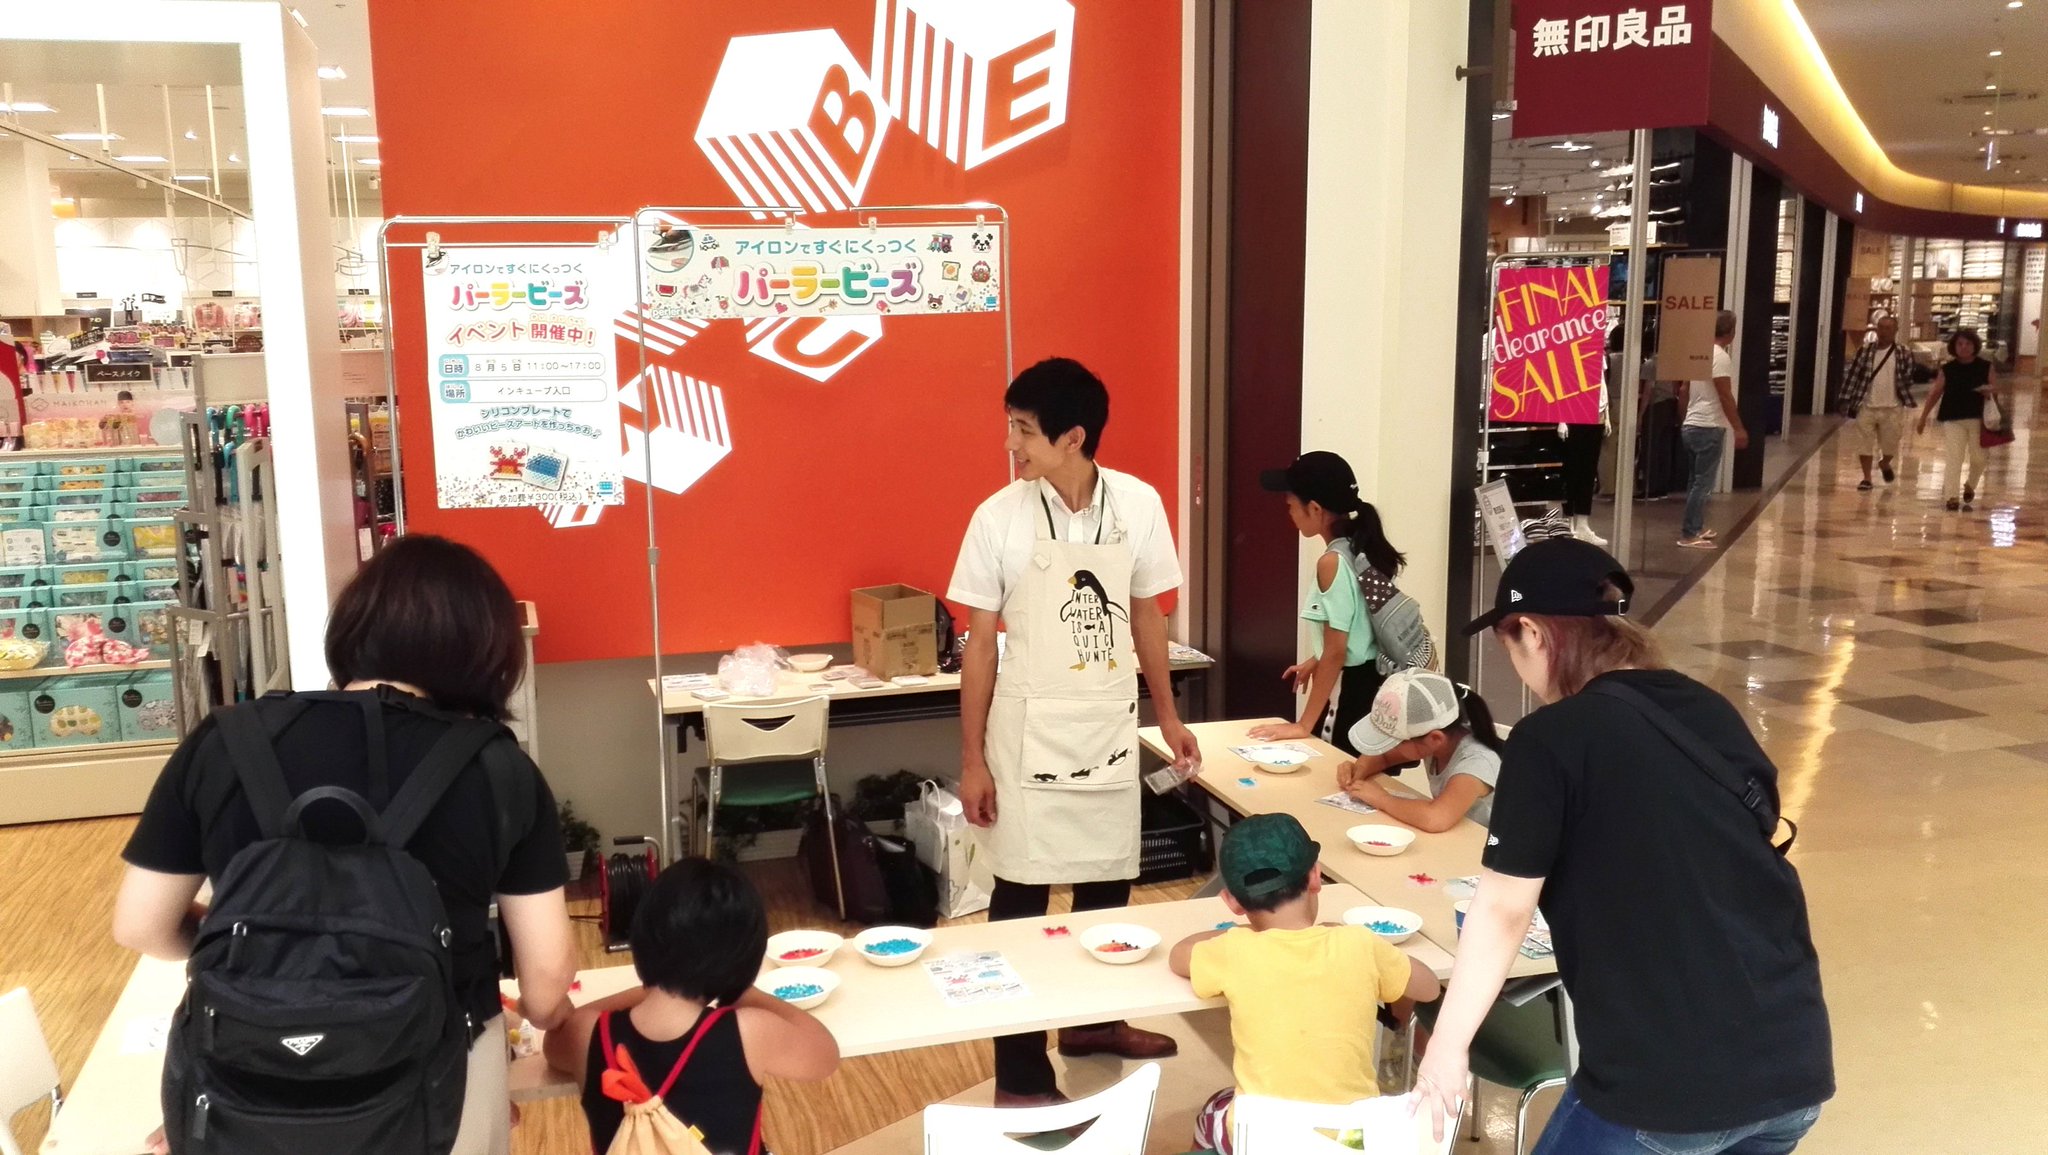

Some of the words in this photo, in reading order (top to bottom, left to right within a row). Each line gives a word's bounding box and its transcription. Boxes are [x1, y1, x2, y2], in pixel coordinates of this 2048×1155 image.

[1533, 5, 1692, 58] 無印良品
[735, 238, 917, 256] アイロンですぐにくっつく
[738, 262, 918, 299] パーラービーズ
[451, 280, 584, 306] パーラービーズ
[1498, 266, 1610, 333] FINAL
[1665, 296, 1715, 310] SALE
[1494, 309, 1608, 364] clearance
[97, 370, 141, 378] ベースメイク
[444, 364, 463, 374] 日時
[1492, 336, 1602, 419] SALE
[445, 389, 465, 399] 場所
[1071, 589, 1098, 603] INTER
[1070, 606, 1103, 622] WATER
[1072, 620, 1082, 634] IS
[1098, 620, 1106, 633] A
[1073, 634, 1109, 648] QUIC
[1077, 647, 1113, 662] HUNTE
